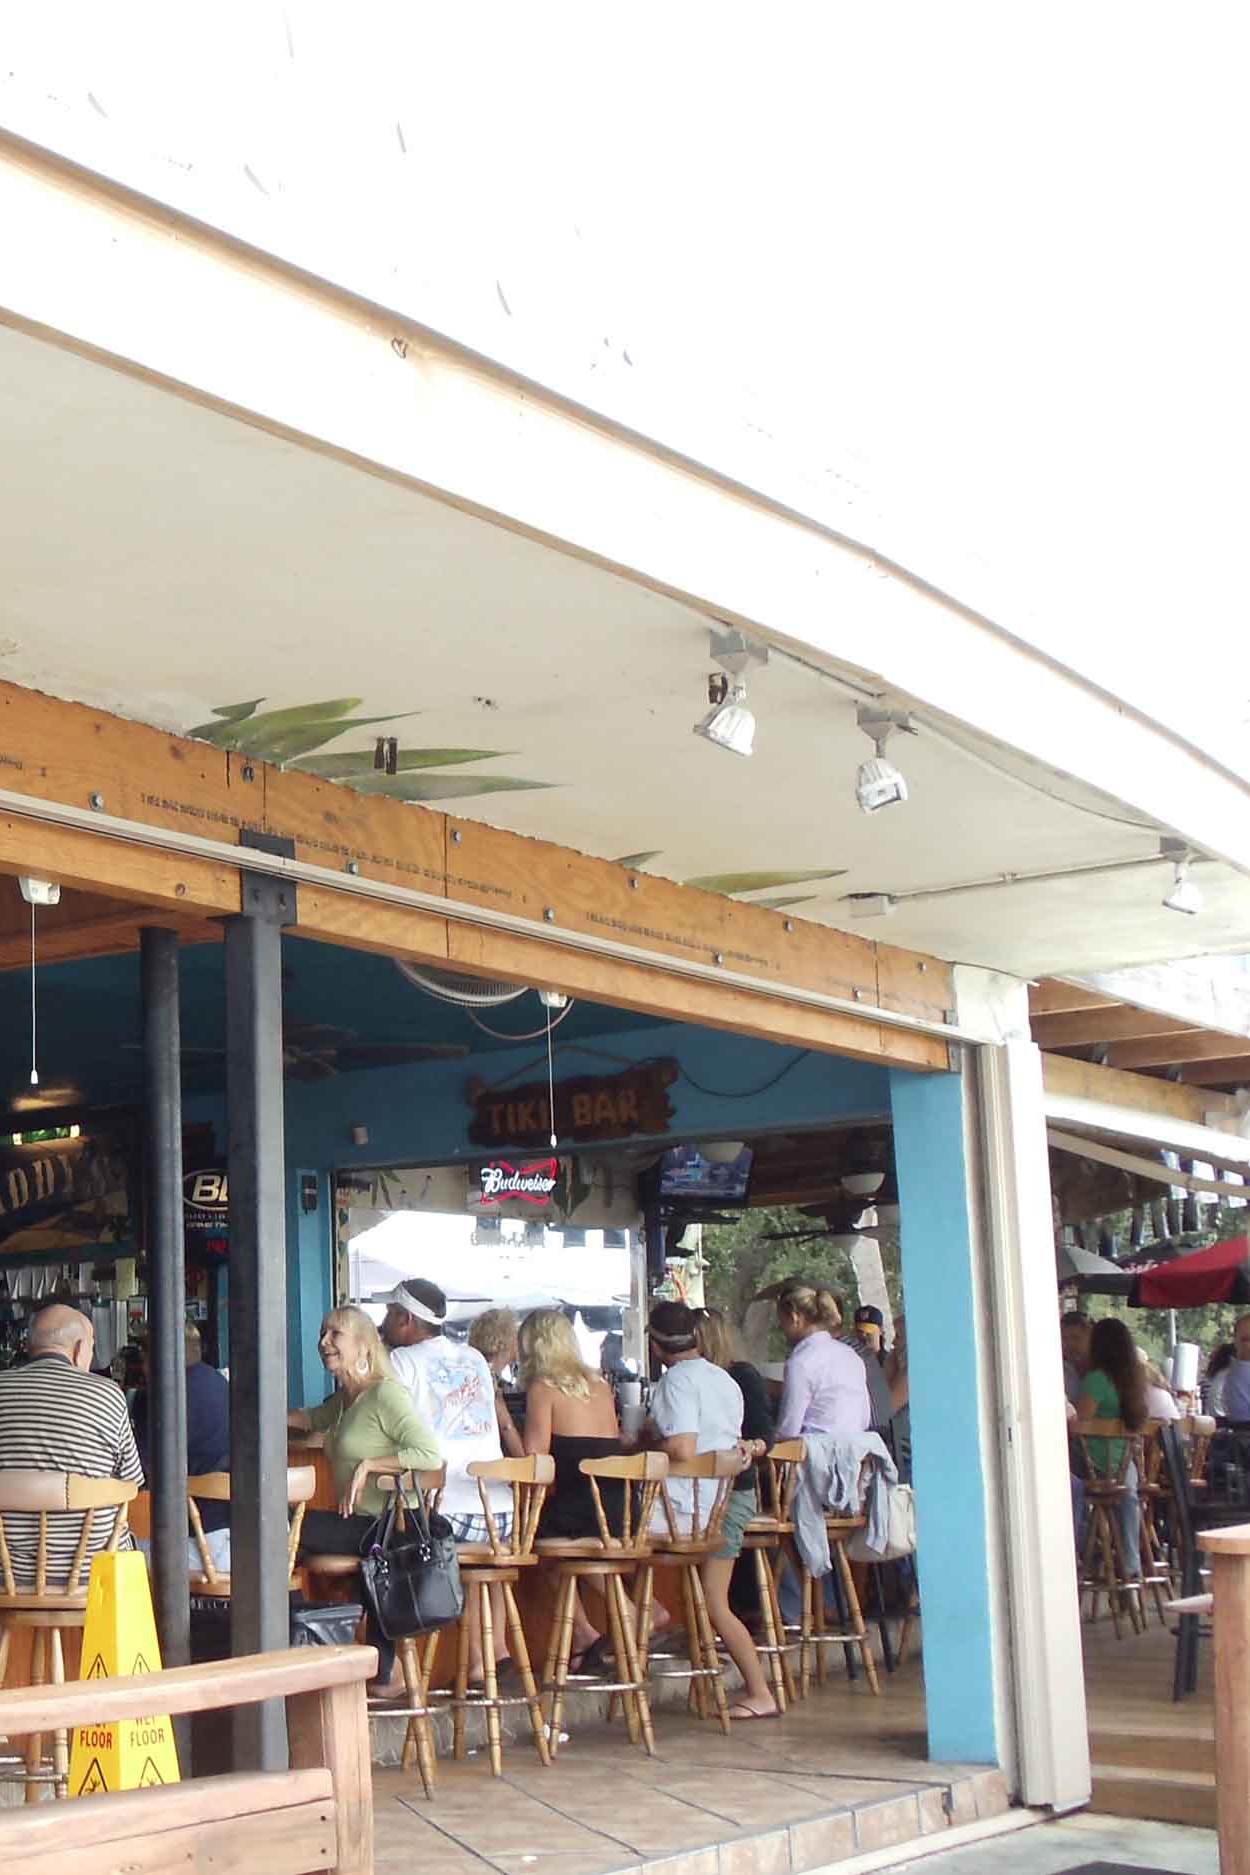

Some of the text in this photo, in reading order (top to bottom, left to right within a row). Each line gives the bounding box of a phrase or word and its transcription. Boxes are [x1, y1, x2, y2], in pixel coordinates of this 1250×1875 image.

[490, 1086, 640, 1136] TIKI BAR
[480, 1167, 556, 1193] Budweiser
[80, 1730, 113, 1750] FLOOR
[130, 1728, 166, 1748] FLOOR
